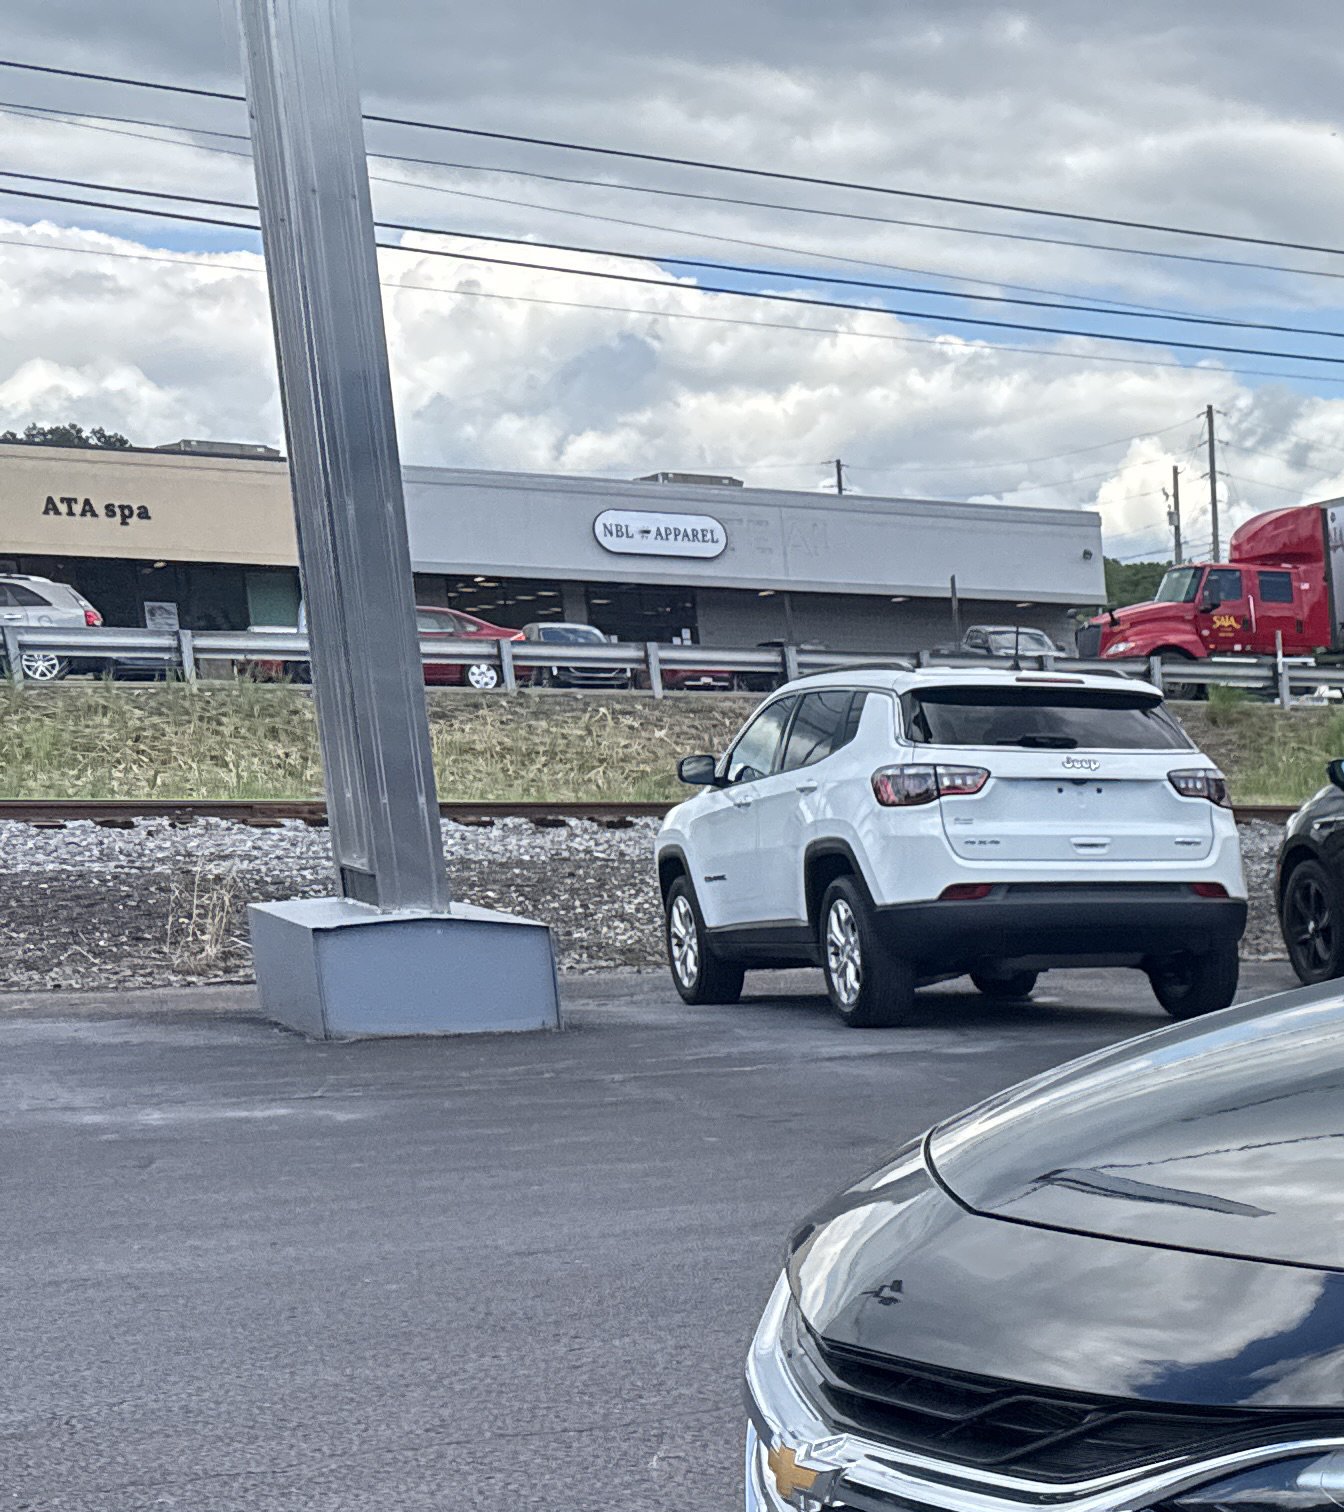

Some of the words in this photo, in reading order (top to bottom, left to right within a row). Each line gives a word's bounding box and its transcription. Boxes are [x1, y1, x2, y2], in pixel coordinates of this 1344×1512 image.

[42, 496, 99, 518] ATA
[104, 503, 152, 526] spa
[602, 523, 634, 539] NBL
[654, 526, 719, 544] APPAREL
[1062, 756, 1100, 772] Jeep
